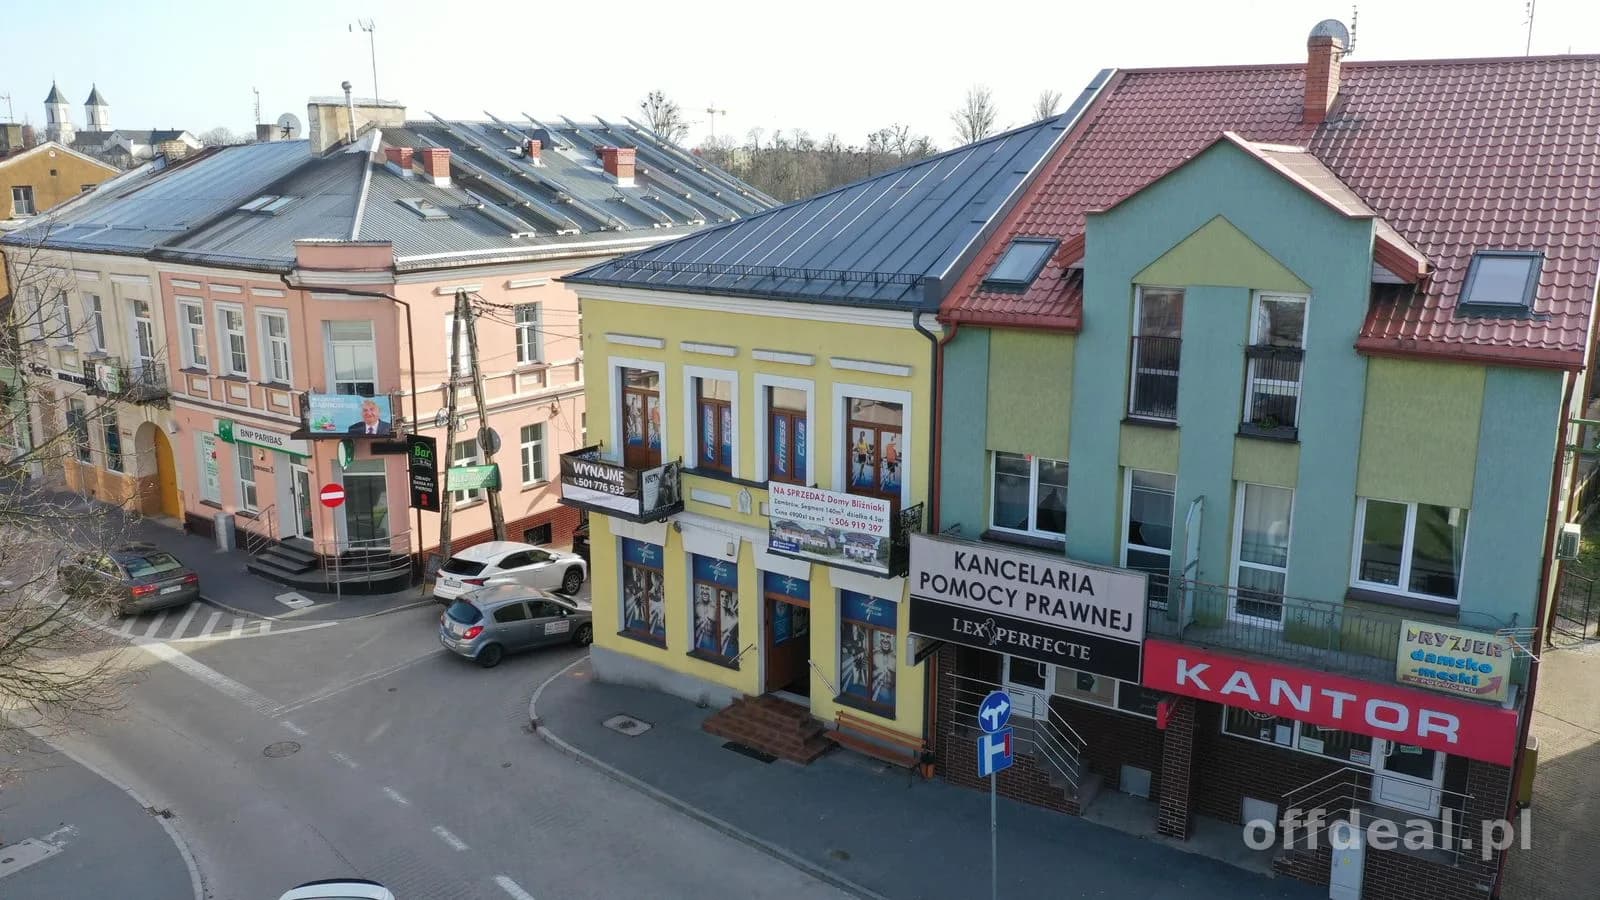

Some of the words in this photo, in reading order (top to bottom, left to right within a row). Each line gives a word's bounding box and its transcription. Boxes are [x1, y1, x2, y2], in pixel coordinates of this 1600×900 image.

[240, 428, 254, 439] BNP
[254, 432, 283, 446] PARIBAS
[706, 407, 715, 461] FITNESS
[778, 418, 787, 473] FITNESS
[797, 421, 806, 457] CLUB
[414, 446, 430, 457] Bar
[573, 461, 625, 486] WYNAJMĘ
[578, 478, 592, 489] 501
[594, 481, 608, 492] 776
[609, 484, 625, 496] 932
[773, 486, 785, 496] NA
[786, 488, 826, 503] SPRZEDAŻ
[827, 495, 850, 507] Domy
[851, 500, 885, 512] Bliźniaki
[835, 517, 850, 527] 506
[851, 521, 866, 530] 919
[868, 523, 883, 533] 397
[954, 550, 1095, 596] KANCELARIA
[920, 571, 1018, 608] POMOCY
[1025, 592, 1133, 633] PRAWNEJ
[952, 617, 986, 638] LEX
[995, 627, 1091, 661] PERFECTE
[1410, 648, 1493, 674] damsko
[1176, 658, 1461, 745] KANTOR
